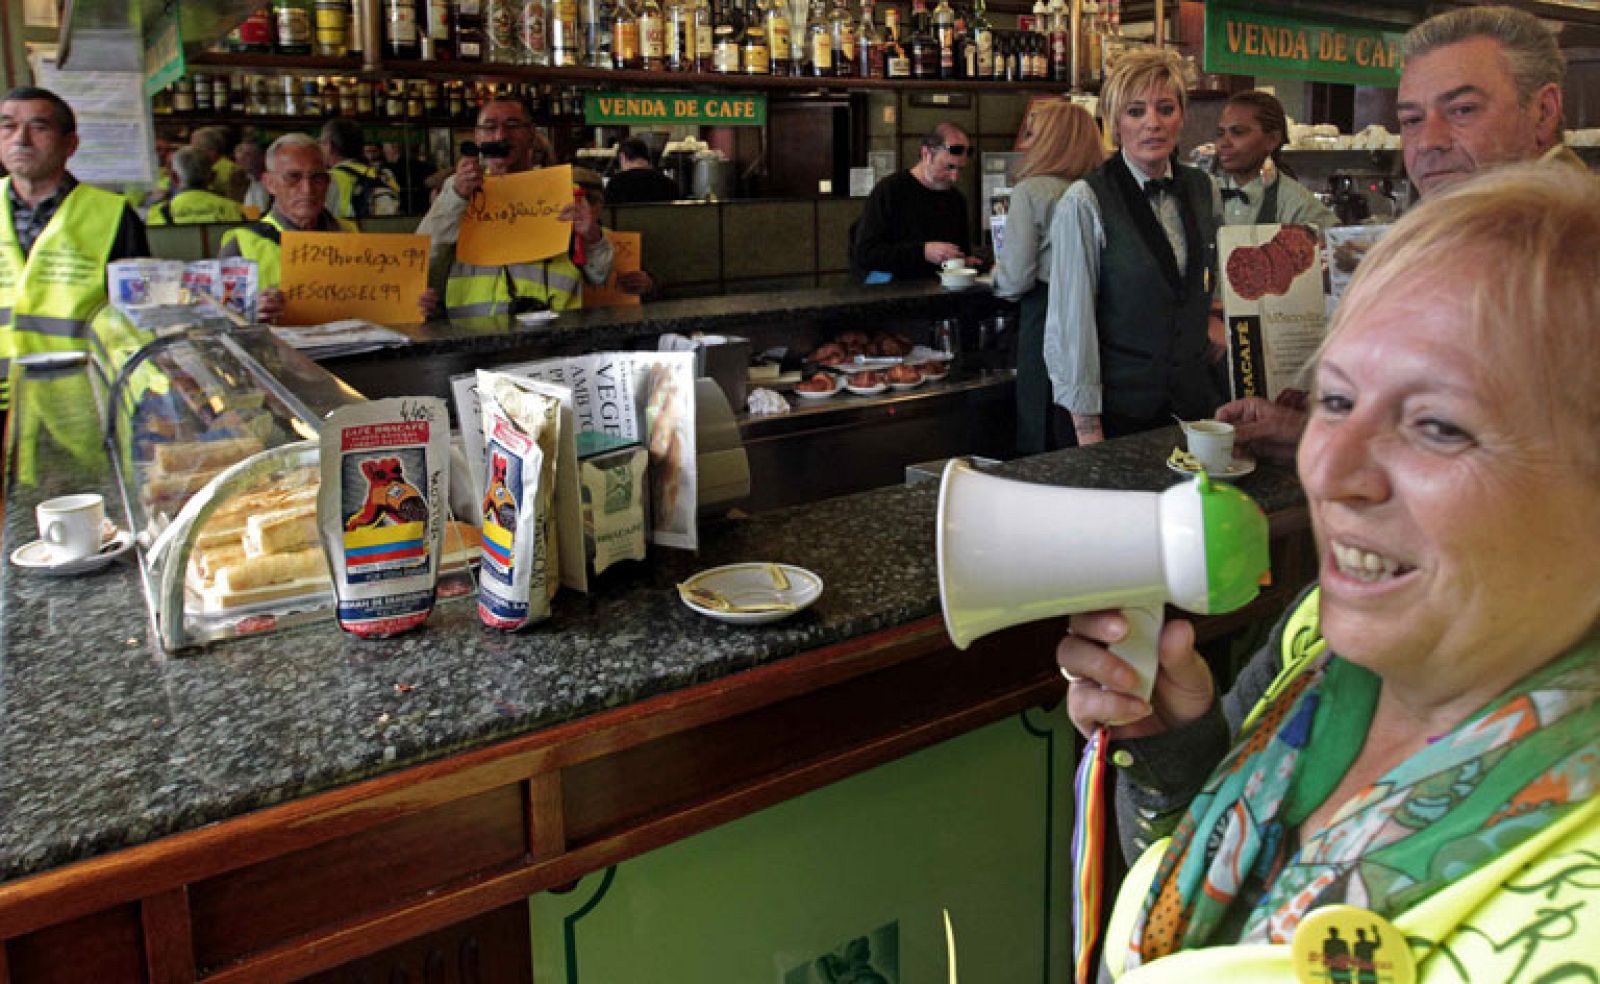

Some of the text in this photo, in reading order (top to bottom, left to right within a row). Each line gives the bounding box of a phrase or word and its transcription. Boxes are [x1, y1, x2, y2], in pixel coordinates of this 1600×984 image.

[1226, 20, 1310, 60] VENDA
[1318, 31, 1349, 62] DE
[599, 97, 668, 117] VENDA
[674, 99, 699, 118] DE
[595, 361, 621, 439] VEGE
